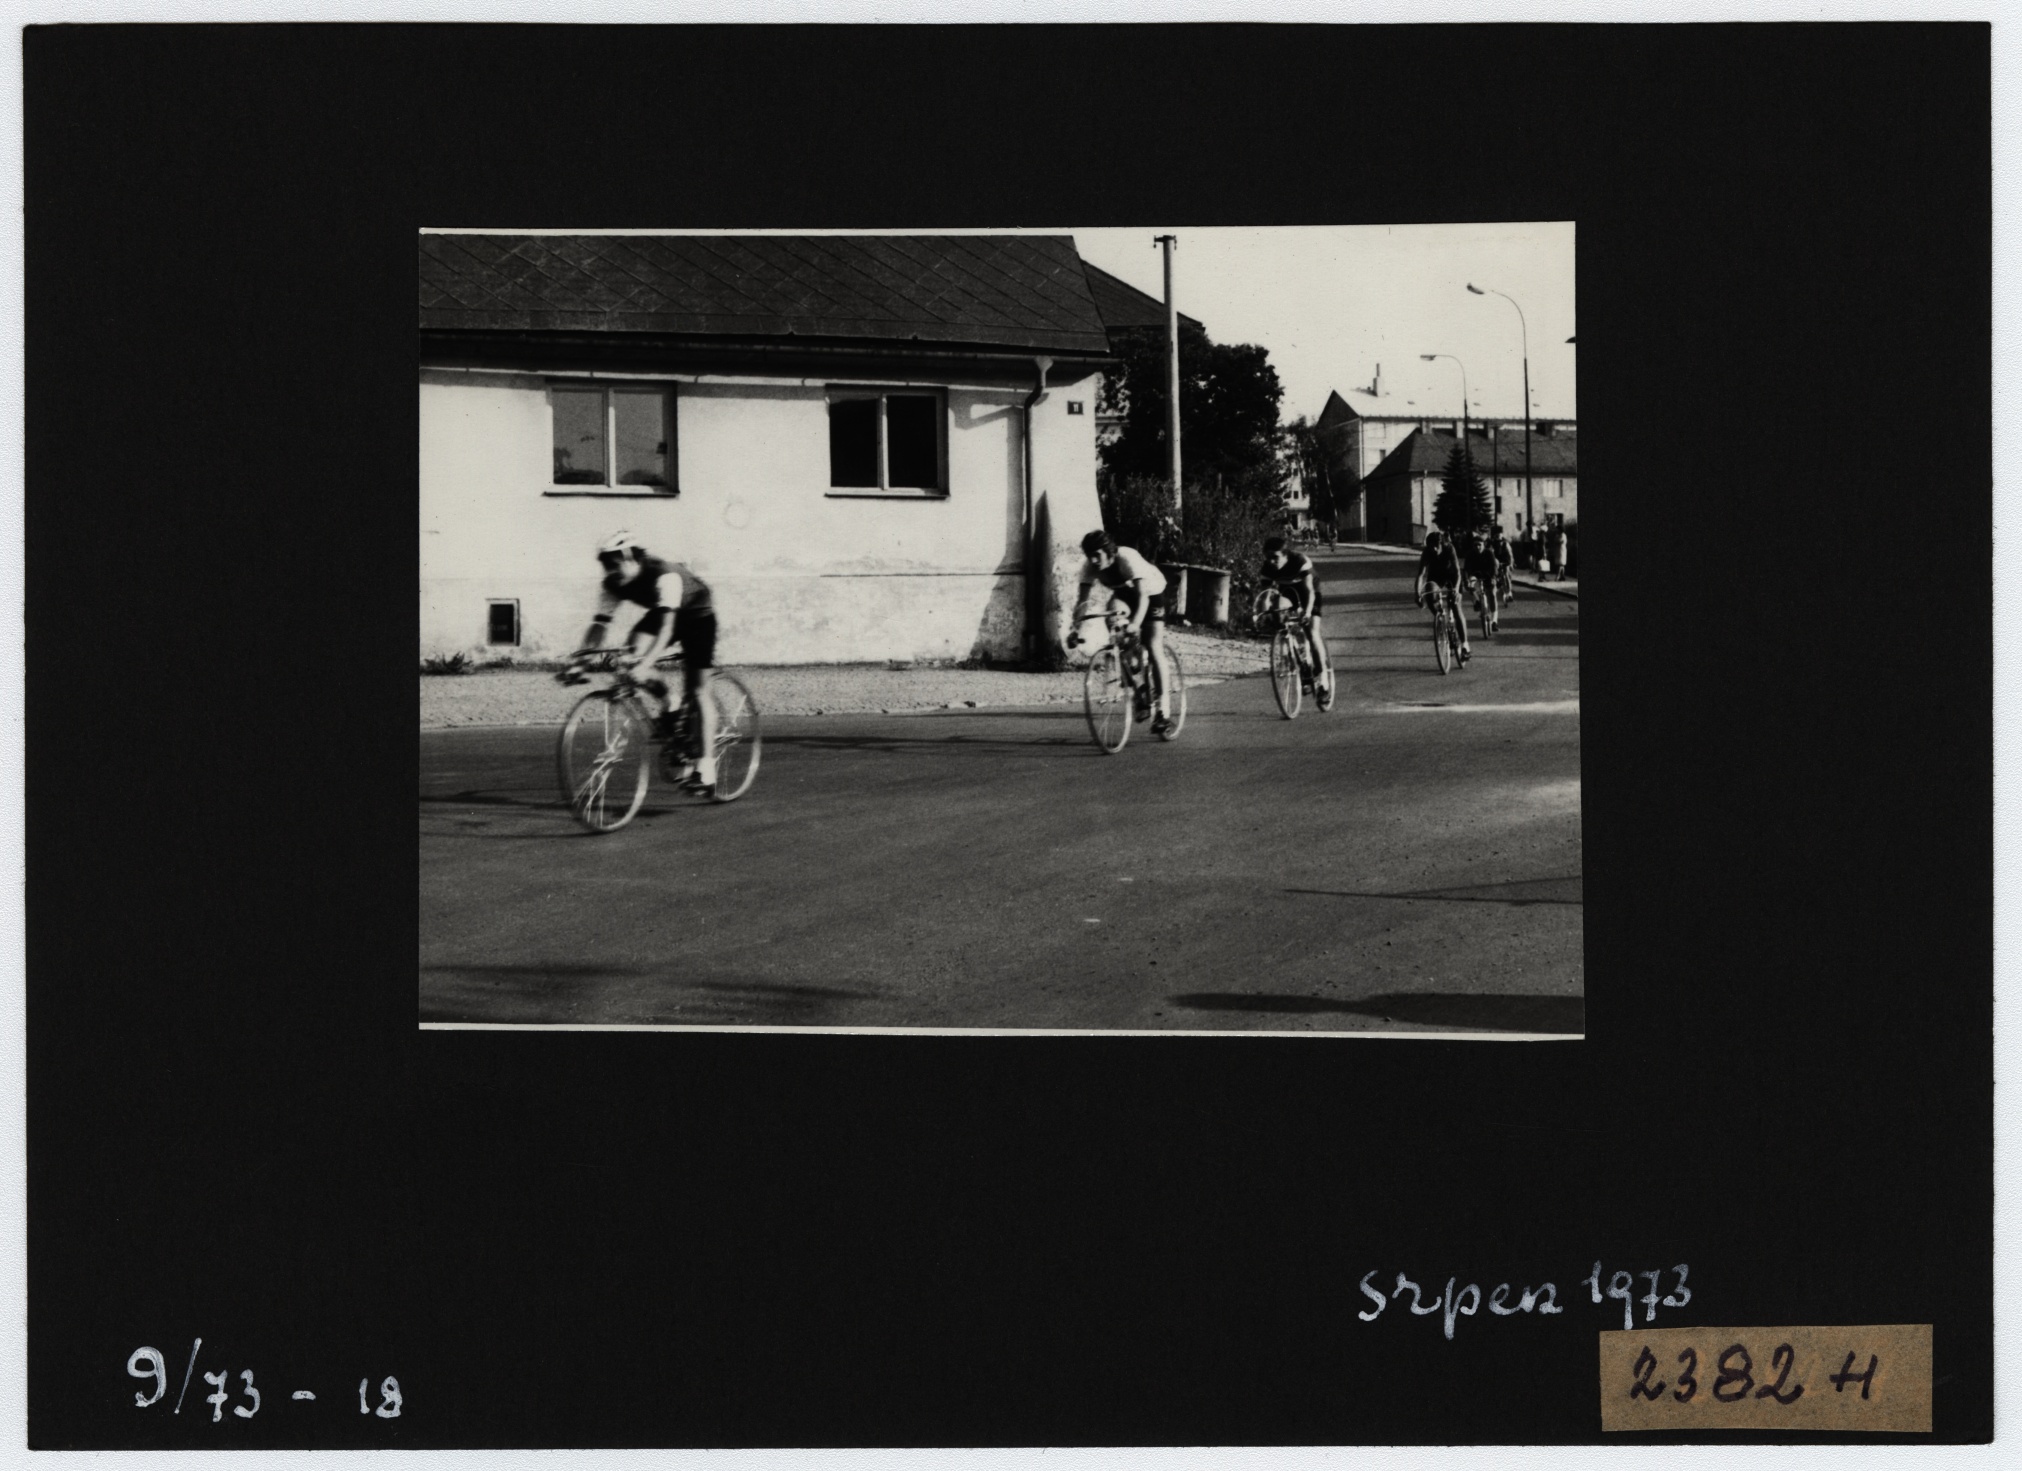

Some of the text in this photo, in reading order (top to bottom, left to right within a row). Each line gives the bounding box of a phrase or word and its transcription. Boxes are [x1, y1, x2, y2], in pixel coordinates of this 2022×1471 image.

[1581, 1261, 1693, 1331] 1973
[127, 1338, 261, 1422] 9/73
[358, 1376, 403, 1419] 18
[1628, 1343, 1879, 1405] 2382 H
